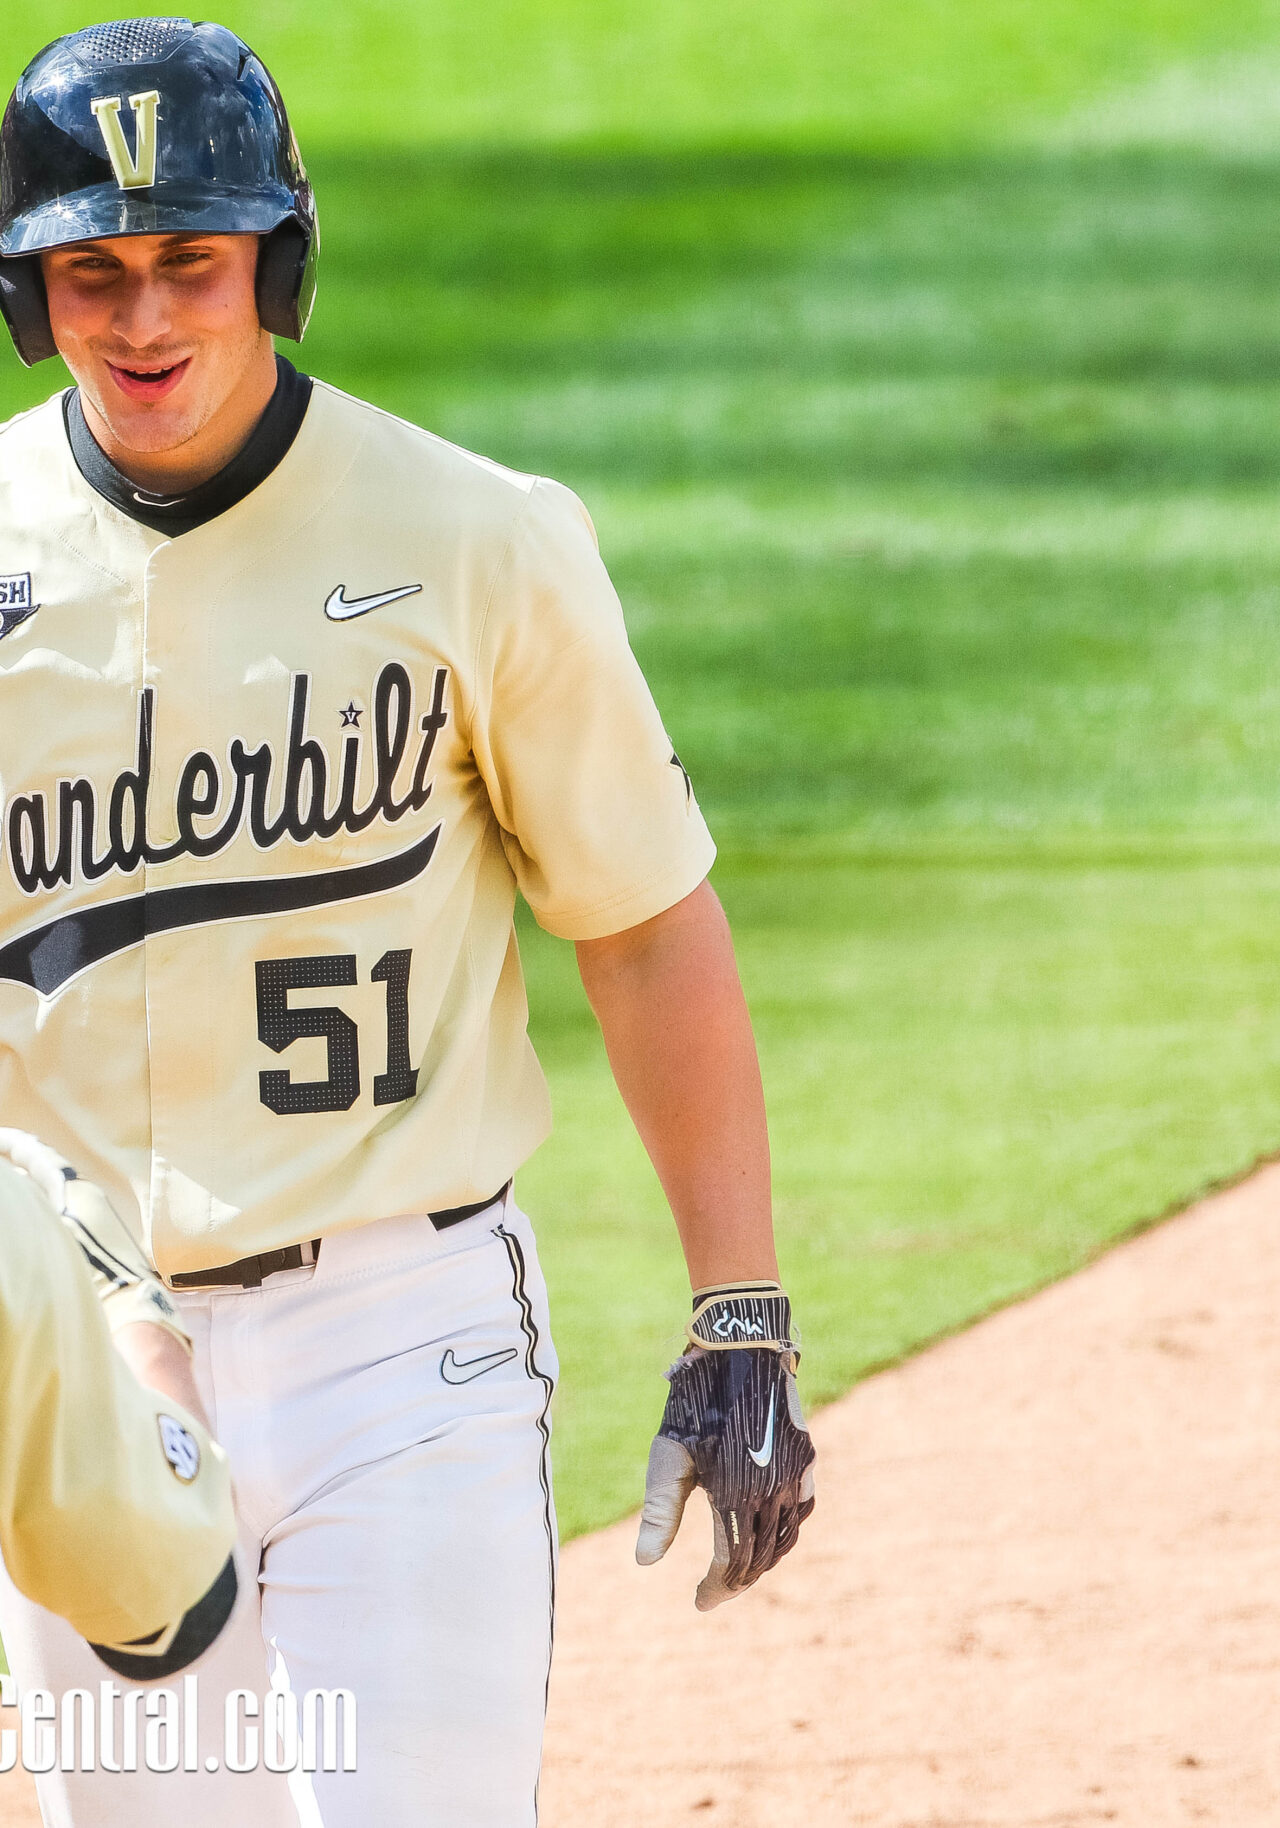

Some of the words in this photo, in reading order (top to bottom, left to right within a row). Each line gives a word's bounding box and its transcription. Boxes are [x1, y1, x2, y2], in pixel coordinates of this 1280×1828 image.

[90, 90, 160, 190] V
[255, 948, 420, 1115] 51
[712, 1309, 763, 1337] MVP
